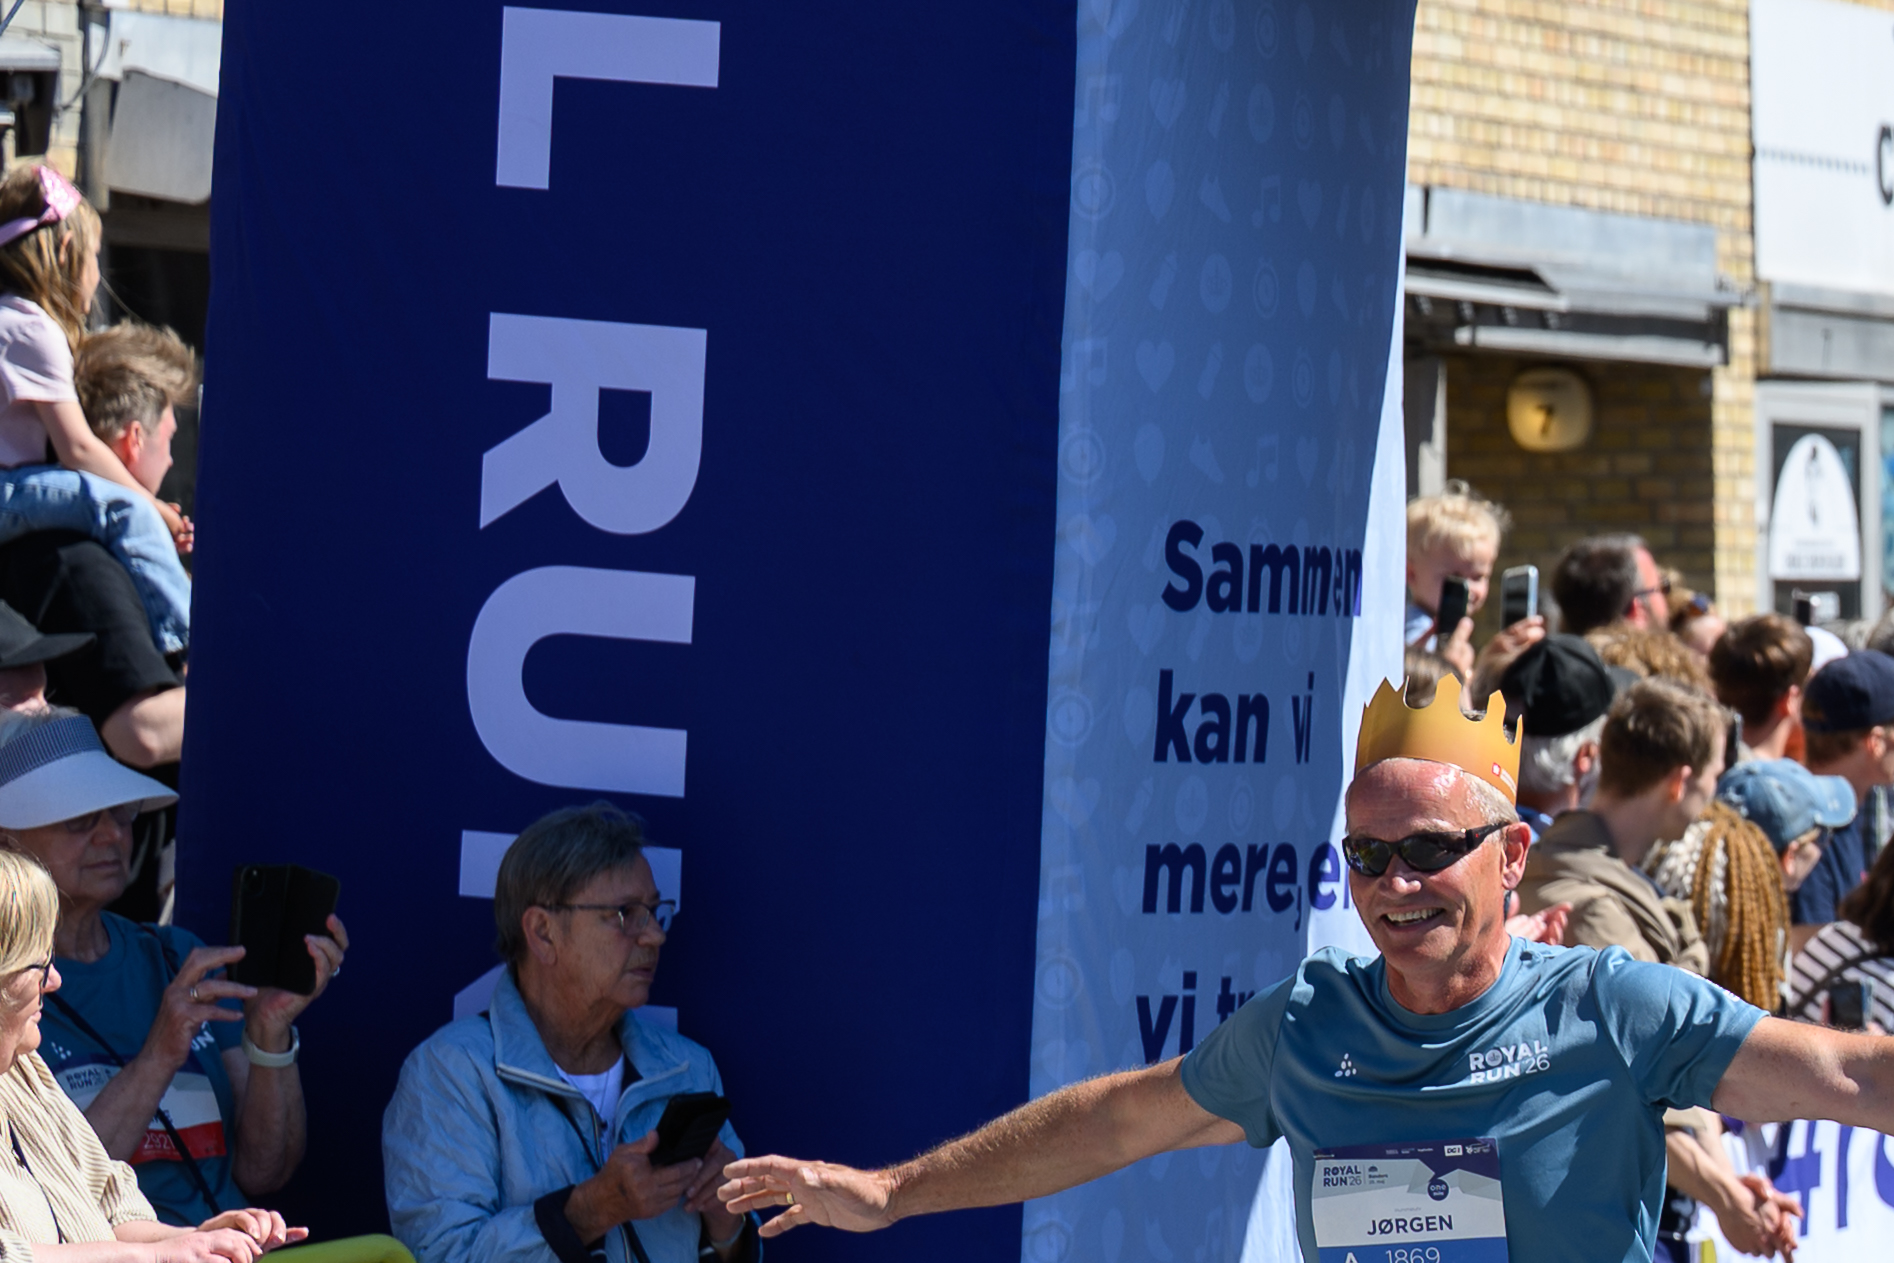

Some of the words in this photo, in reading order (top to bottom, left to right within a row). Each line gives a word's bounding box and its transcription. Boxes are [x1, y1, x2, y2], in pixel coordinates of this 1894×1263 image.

[1161, 519, 1363, 617] Sammen
[1153, 668, 1271, 765] kan
[1292, 671, 1315, 765] vi
[1142, 842, 1303, 932] mere,
[1136, 971, 1198, 1065] vi
[1469, 1040, 1548, 1071] ROYAL
[1323, 1165, 1362, 1177] ROYAL
[1367, 1214, 1453, 1235] JØRGEN
